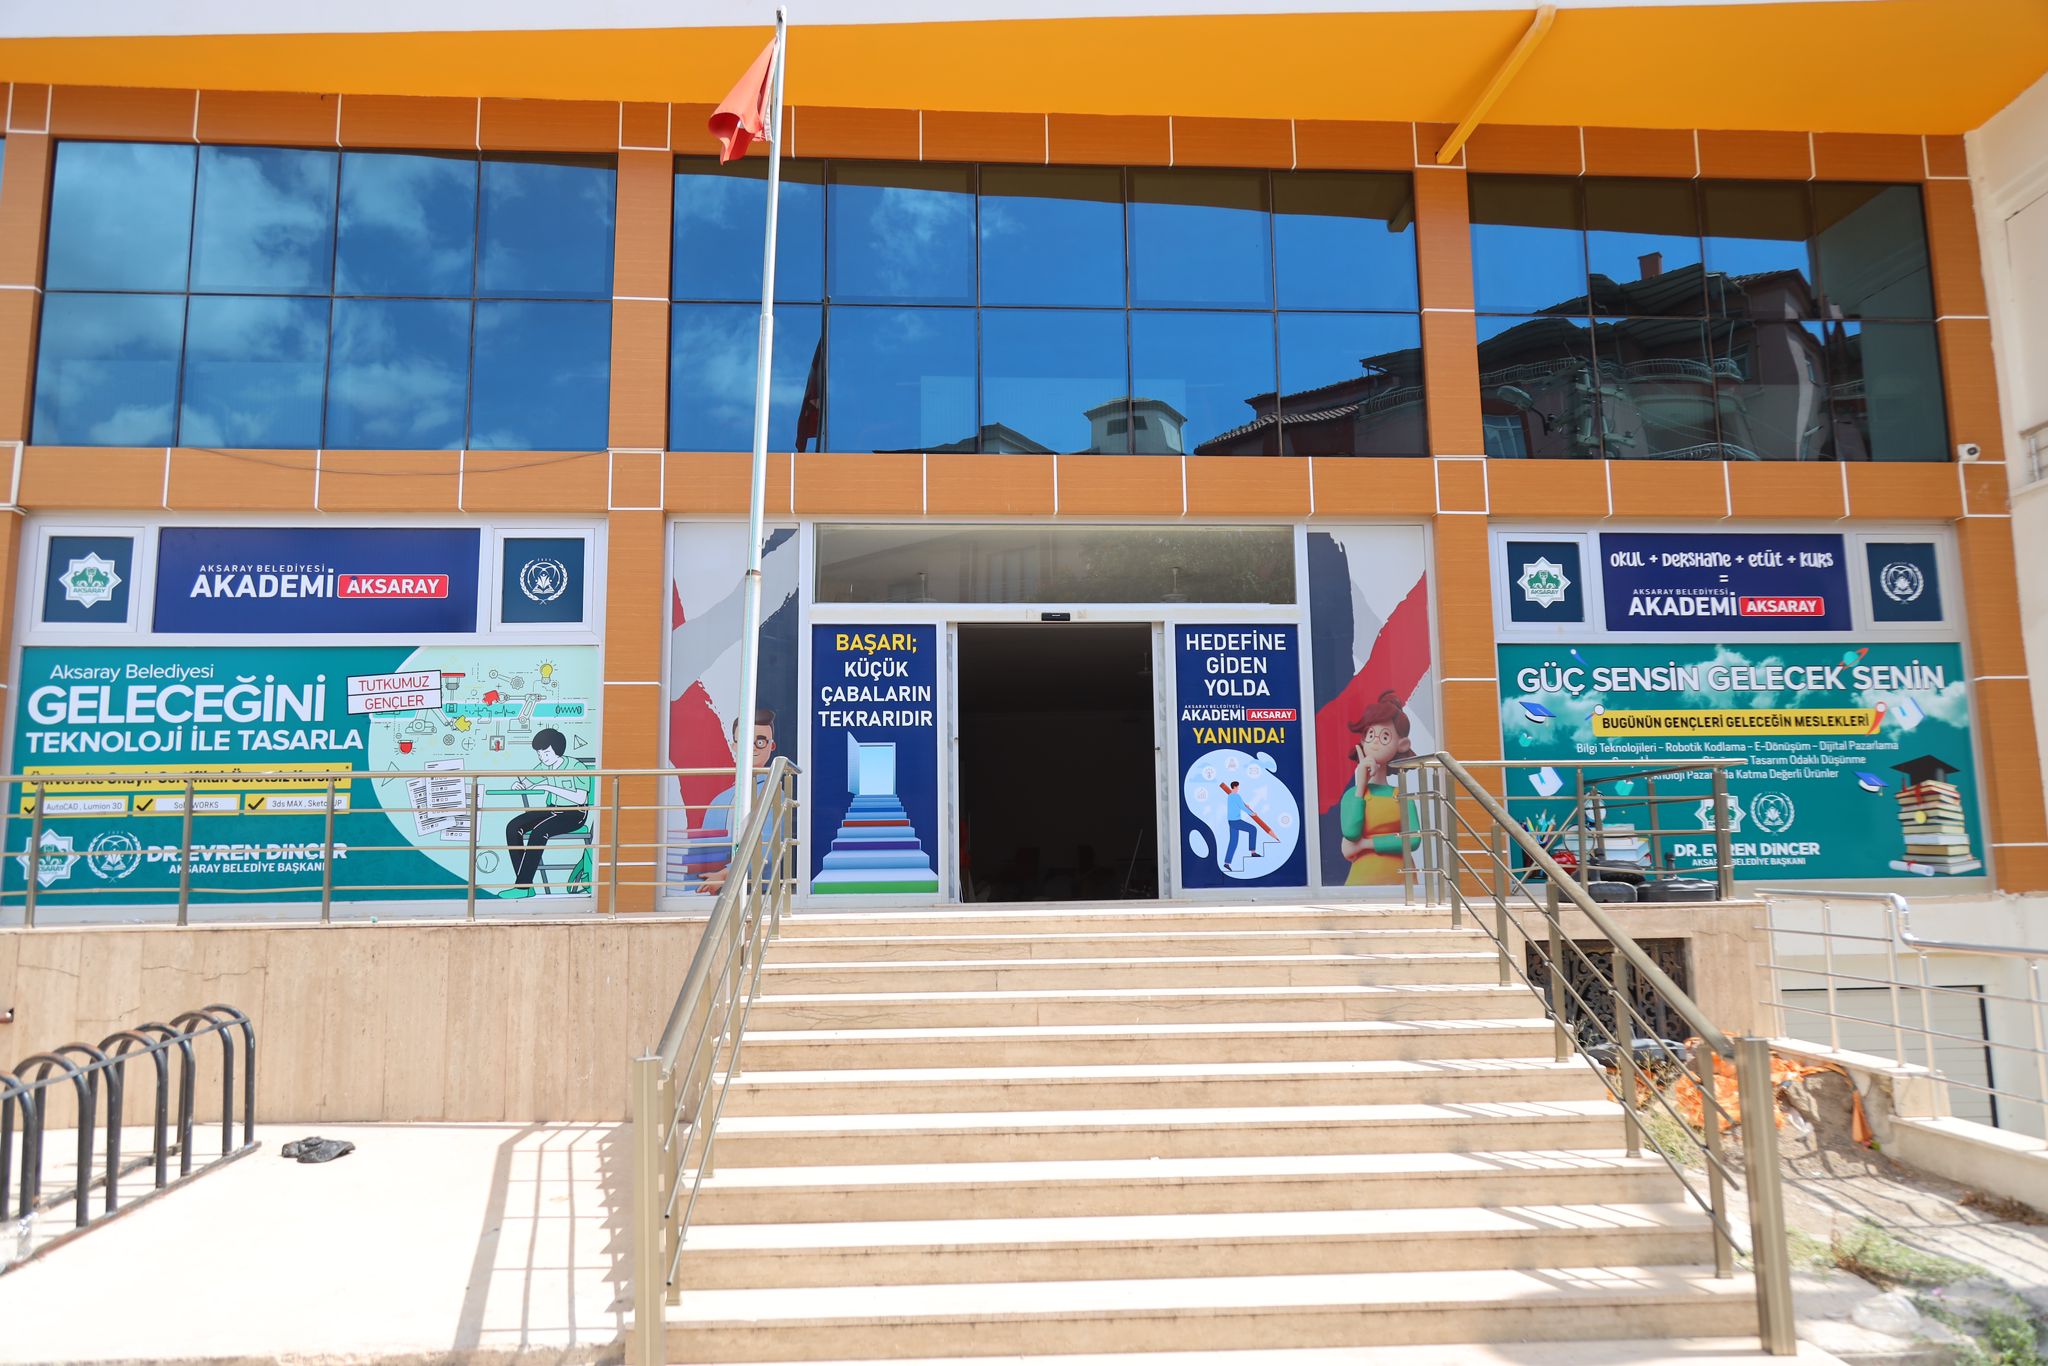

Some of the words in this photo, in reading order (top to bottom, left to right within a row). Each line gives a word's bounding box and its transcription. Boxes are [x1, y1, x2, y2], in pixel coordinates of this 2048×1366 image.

[257, 563, 325, 572] BELEDİYESİ
[190, 568, 334, 598] AKADEMİ
[346, 578, 440, 594] AKSARAY
[1676, 586, 1728, 595] BELEDİYESİ
[1628, 591, 1737, 616] AKADEMİ
[1747, 600, 1817, 613] AKSARAY
[836, 633, 917, 655] BAŞARI;
[1186, 629, 1286, 651] HEDEFİNE
[844, 657, 909, 681] KÜÇÜK
[1206, 653, 1267, 674] GİDEN
[50, 664, 121, 683] Aksaray
[126, 664, 215, 682] Belediyesi
[1517, 660, 1585, 696] GÜÇ
[1592, 660, 1700, 692] SENSİN
[1707, 665, 1846, 691] GELECEK
[1852, 658, 1945, 691] SENİN
[358, 676, 430, 692] TUTKUMUZ
[1204, 679, 1270, 696] YOLDA
[28, 674, 326, 725] GELECEĞİNİ
[365, 694, 424, 710] GENÇLER
[821, 685, 931, 706] ÇABALARIN
[818, 710, 933, 727] TEKRARIDIR
[1181, 706, 1245, 721] AKADEMİ
[1250, 711, 1293, 719] AKSARAY
[1602, 715, 1662, 729] BUGÜNÜN
[1664, 714, 1724, 731] GENÇLERİ
[1726, 713, 1794, 728] GELECEĞİN
[1795, 714, 1869, 727] MESLEKLERİ
[26, 725, 183, 753] TEKNOLOJİ
[191, 725, 230, 751] İLE
[238, 729, 364, 750] TASARLA
[1192, 727, 1286, 744] YANINDA!
[1576, 742, 1598, 755] Bilgi
[1600, 742, 1657, 754] Teknolojileri
[1665, 741, 1703, 752] Robotik
[1704, 741, 1746, 751] Kodlama
[1819, 740, 1847, 752] Dijital
[1849, 740, 1899, 751] Pazarlama
[1750, 755, 1788, 765] Tasarım
[1790, 754, 1820, 765] Odaklı
[1821, 754, 1866, 767] Düşünme
[1736, 769, 1768, 779] Katma
[1769, 767, 1802, 781] Değerli
[1803, 766, 1839, 778] Ürünler
[287, 800, 303, 808] MAX
[147, 845, 181, 863] DR.
[190, 843, 260, 861] EVREN
[1674, 844, 1701, 857] DR.
[222, 861, 275, 873] BELEDİYE
[1732, 856, 1769, 866] BELEDİYE
[1770, 857, 1806, 867] BAŞKANI
